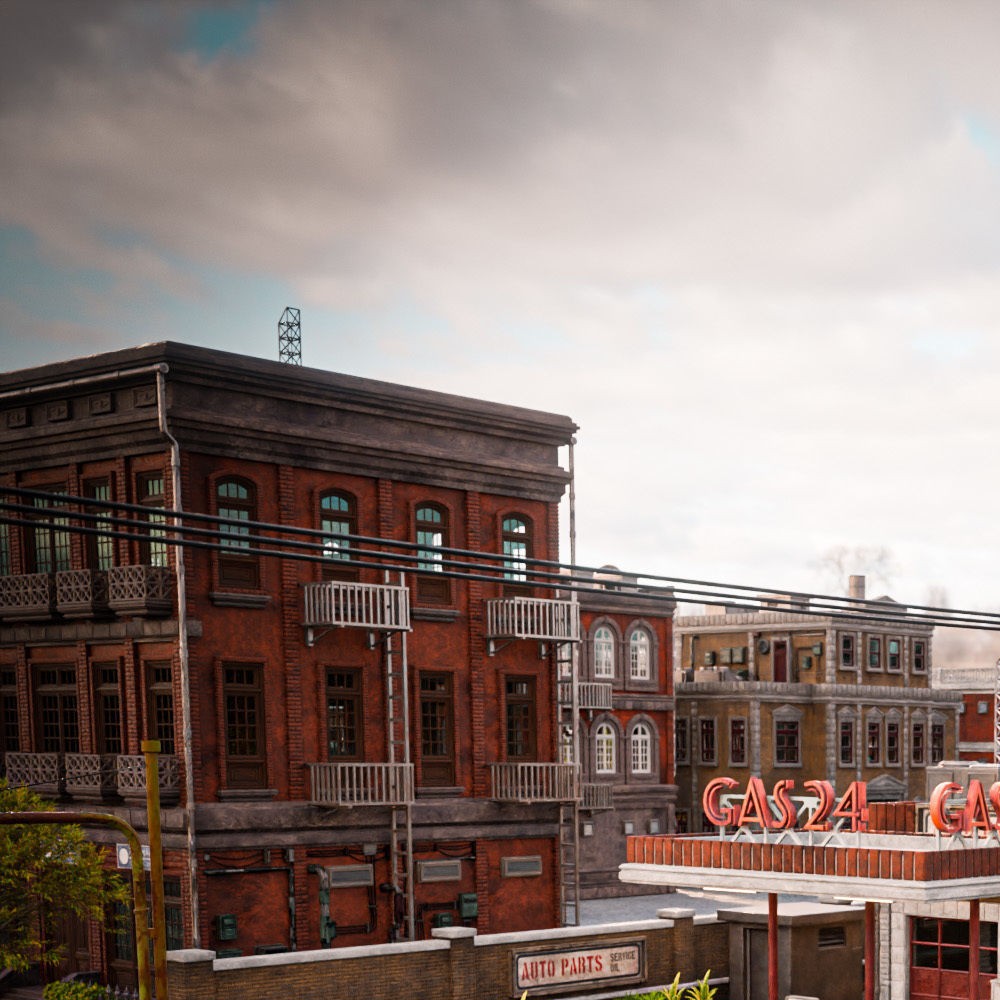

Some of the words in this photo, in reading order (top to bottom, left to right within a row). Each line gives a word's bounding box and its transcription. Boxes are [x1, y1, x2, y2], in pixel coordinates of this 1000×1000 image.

[703, 776, 797, 829] GAS
[803, 780, 869, 832] 24
[522, 960, 556, 981] AUTO
[561, 954, 604, 976] PARTS
